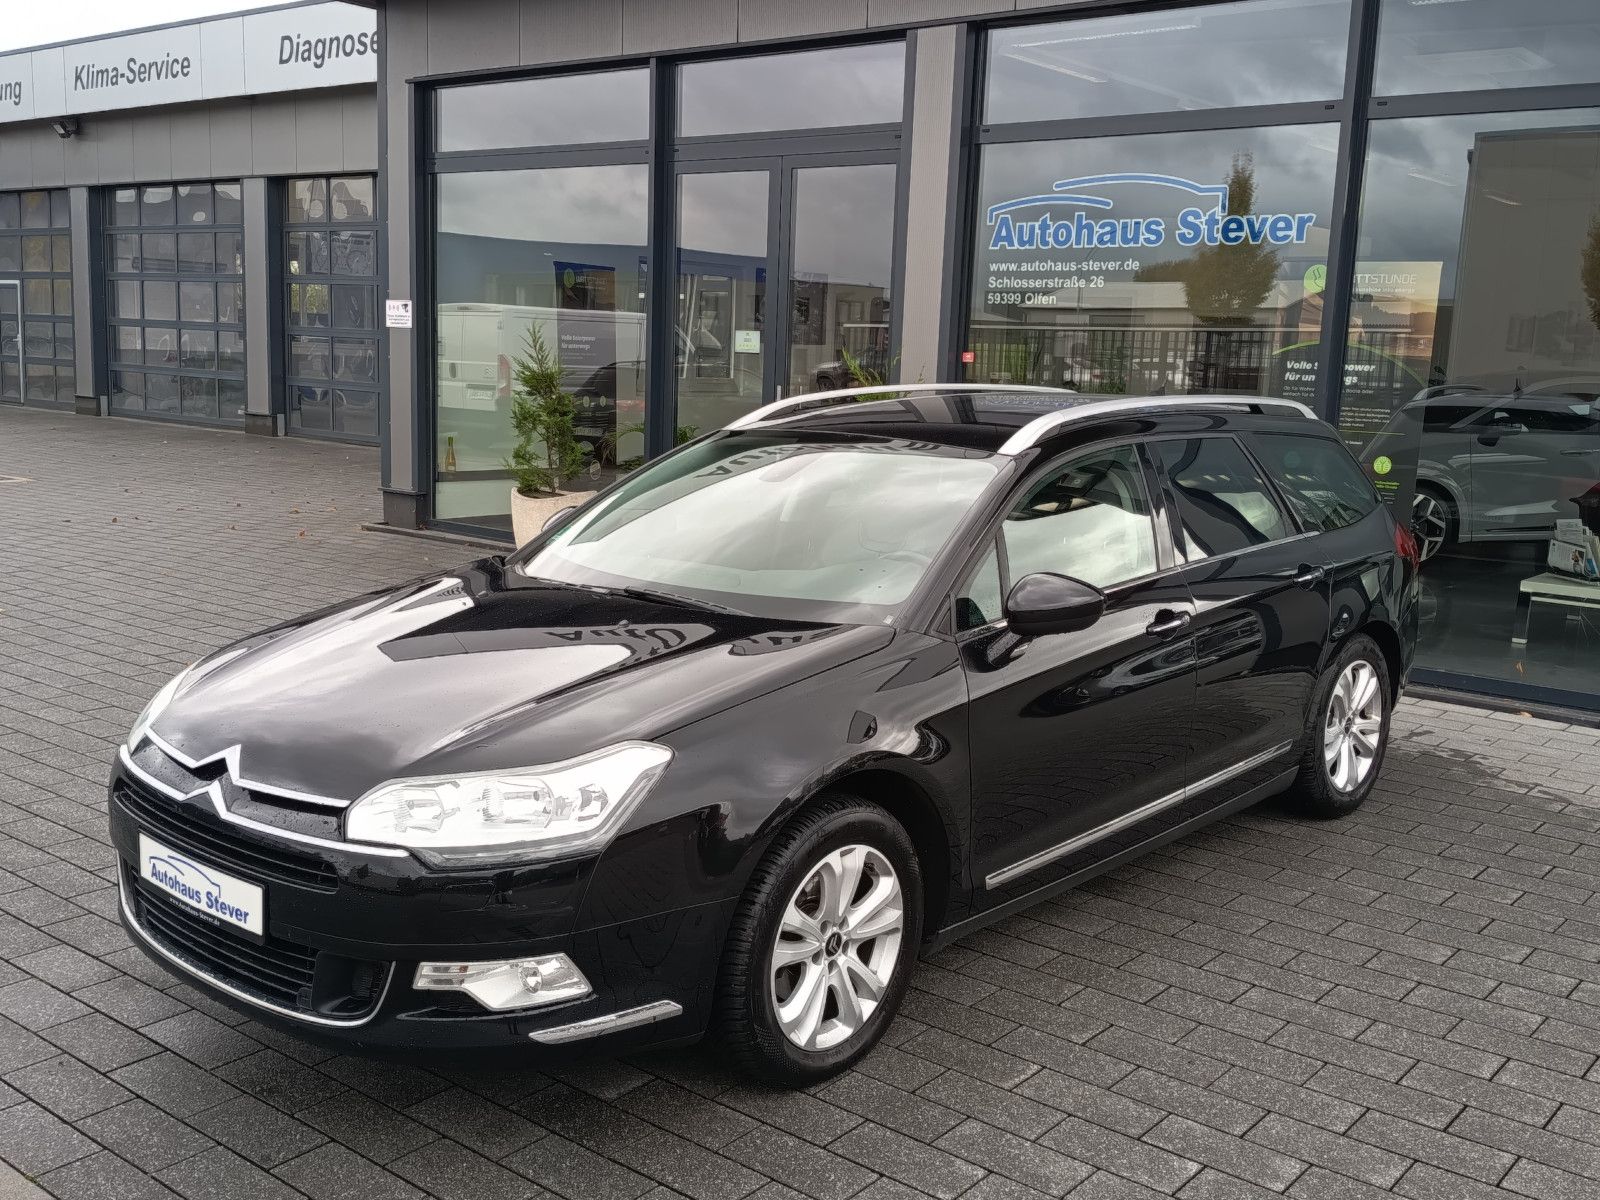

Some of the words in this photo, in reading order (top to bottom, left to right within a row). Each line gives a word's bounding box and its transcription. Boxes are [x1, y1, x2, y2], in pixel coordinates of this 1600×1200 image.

[279, 31, 377, 69] Diagnose
[74, 52, 191, 91] Klima-Service
[989, 211, 1166, 250] Autohaus
[1176, 207, 1316, 246] Stever
[989, 258, 1140, 272] www.autohaus-stever.de
[988, 276, 1087, 289] Schlosserstraße
[1089, 276, 1105, 289] 26
[1353, 273, 1417, 284] TTSTUNDE
[987, 293, 1021, 305] 59399
[1025, 293, 1057, 305] Olfen
[1287, 361, 1312, 370] Volle
[1285, 372, 1300, 380] für
[150, 863, 201, 904] Autohaus
[205, 891, 249, 924] Stever
